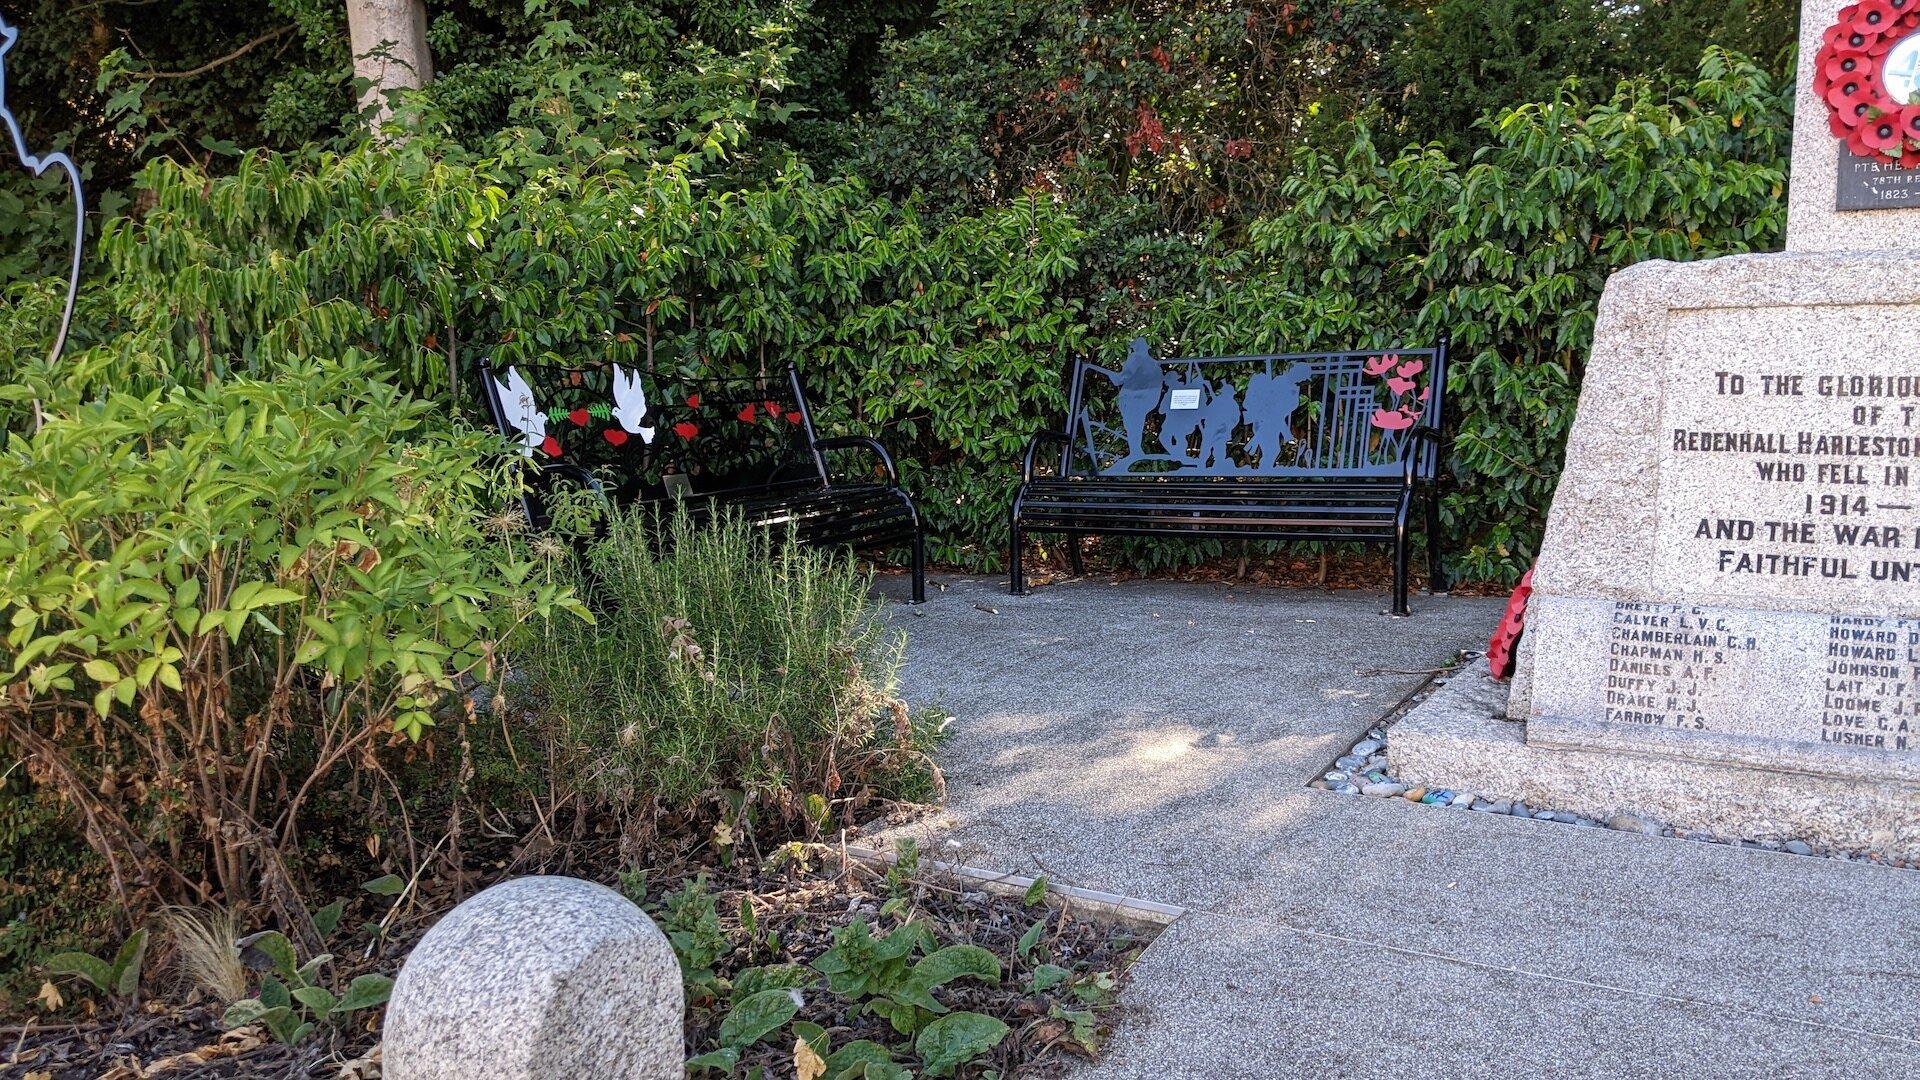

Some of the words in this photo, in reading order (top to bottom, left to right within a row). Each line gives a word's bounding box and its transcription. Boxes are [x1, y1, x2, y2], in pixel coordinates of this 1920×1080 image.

[1873, 176, 1902, 185] 78TH
[1880, 188, 1909, 200] 1823
[1715, 371, 1744, 395] TO
[1761, 375, 1804, 396] THE
[1853, 405, 1882, 426] OF
[1674, 429, 1791, 454] REDENHALL
[1756, 462, 1805, 483] WHO
[1818, 464, 1868, 486] FELL
[1884, 466, 1909, 487] IN
[1694, 519, 1755, 542] AND
[1764, 521, 1816, 544] THE
[1833, 525, 1900, 549] WAR
[1718, 550, 1857, 580] FAITHFUL
[1613, 612, 1669, 628] CALVER
[1611, 626, 1717, 647] CHAMBERLAIN
[1829, 626, 1897, 644] HOWARD
[1610, 642, 1683, 661] CHAPMAN
[1828, 642, 1896, 661] HOWARD
[1609, 658, 1673, 677] DANIELS
[1827, 660, 1899, 679] JOHNSON
[1608, 674, 1656, 692] DUFFY
[1825, 677, 1863, 693] LAIT
[1607, 690, 1656, 709] DRAKE
[1824, 693, 1881, 713] LOOME
[1605, 707, 1665, 726] FARROW
[1822, 711, 1864, 729] LOVE
[1821, 728, 1885, 748] LUSHER
